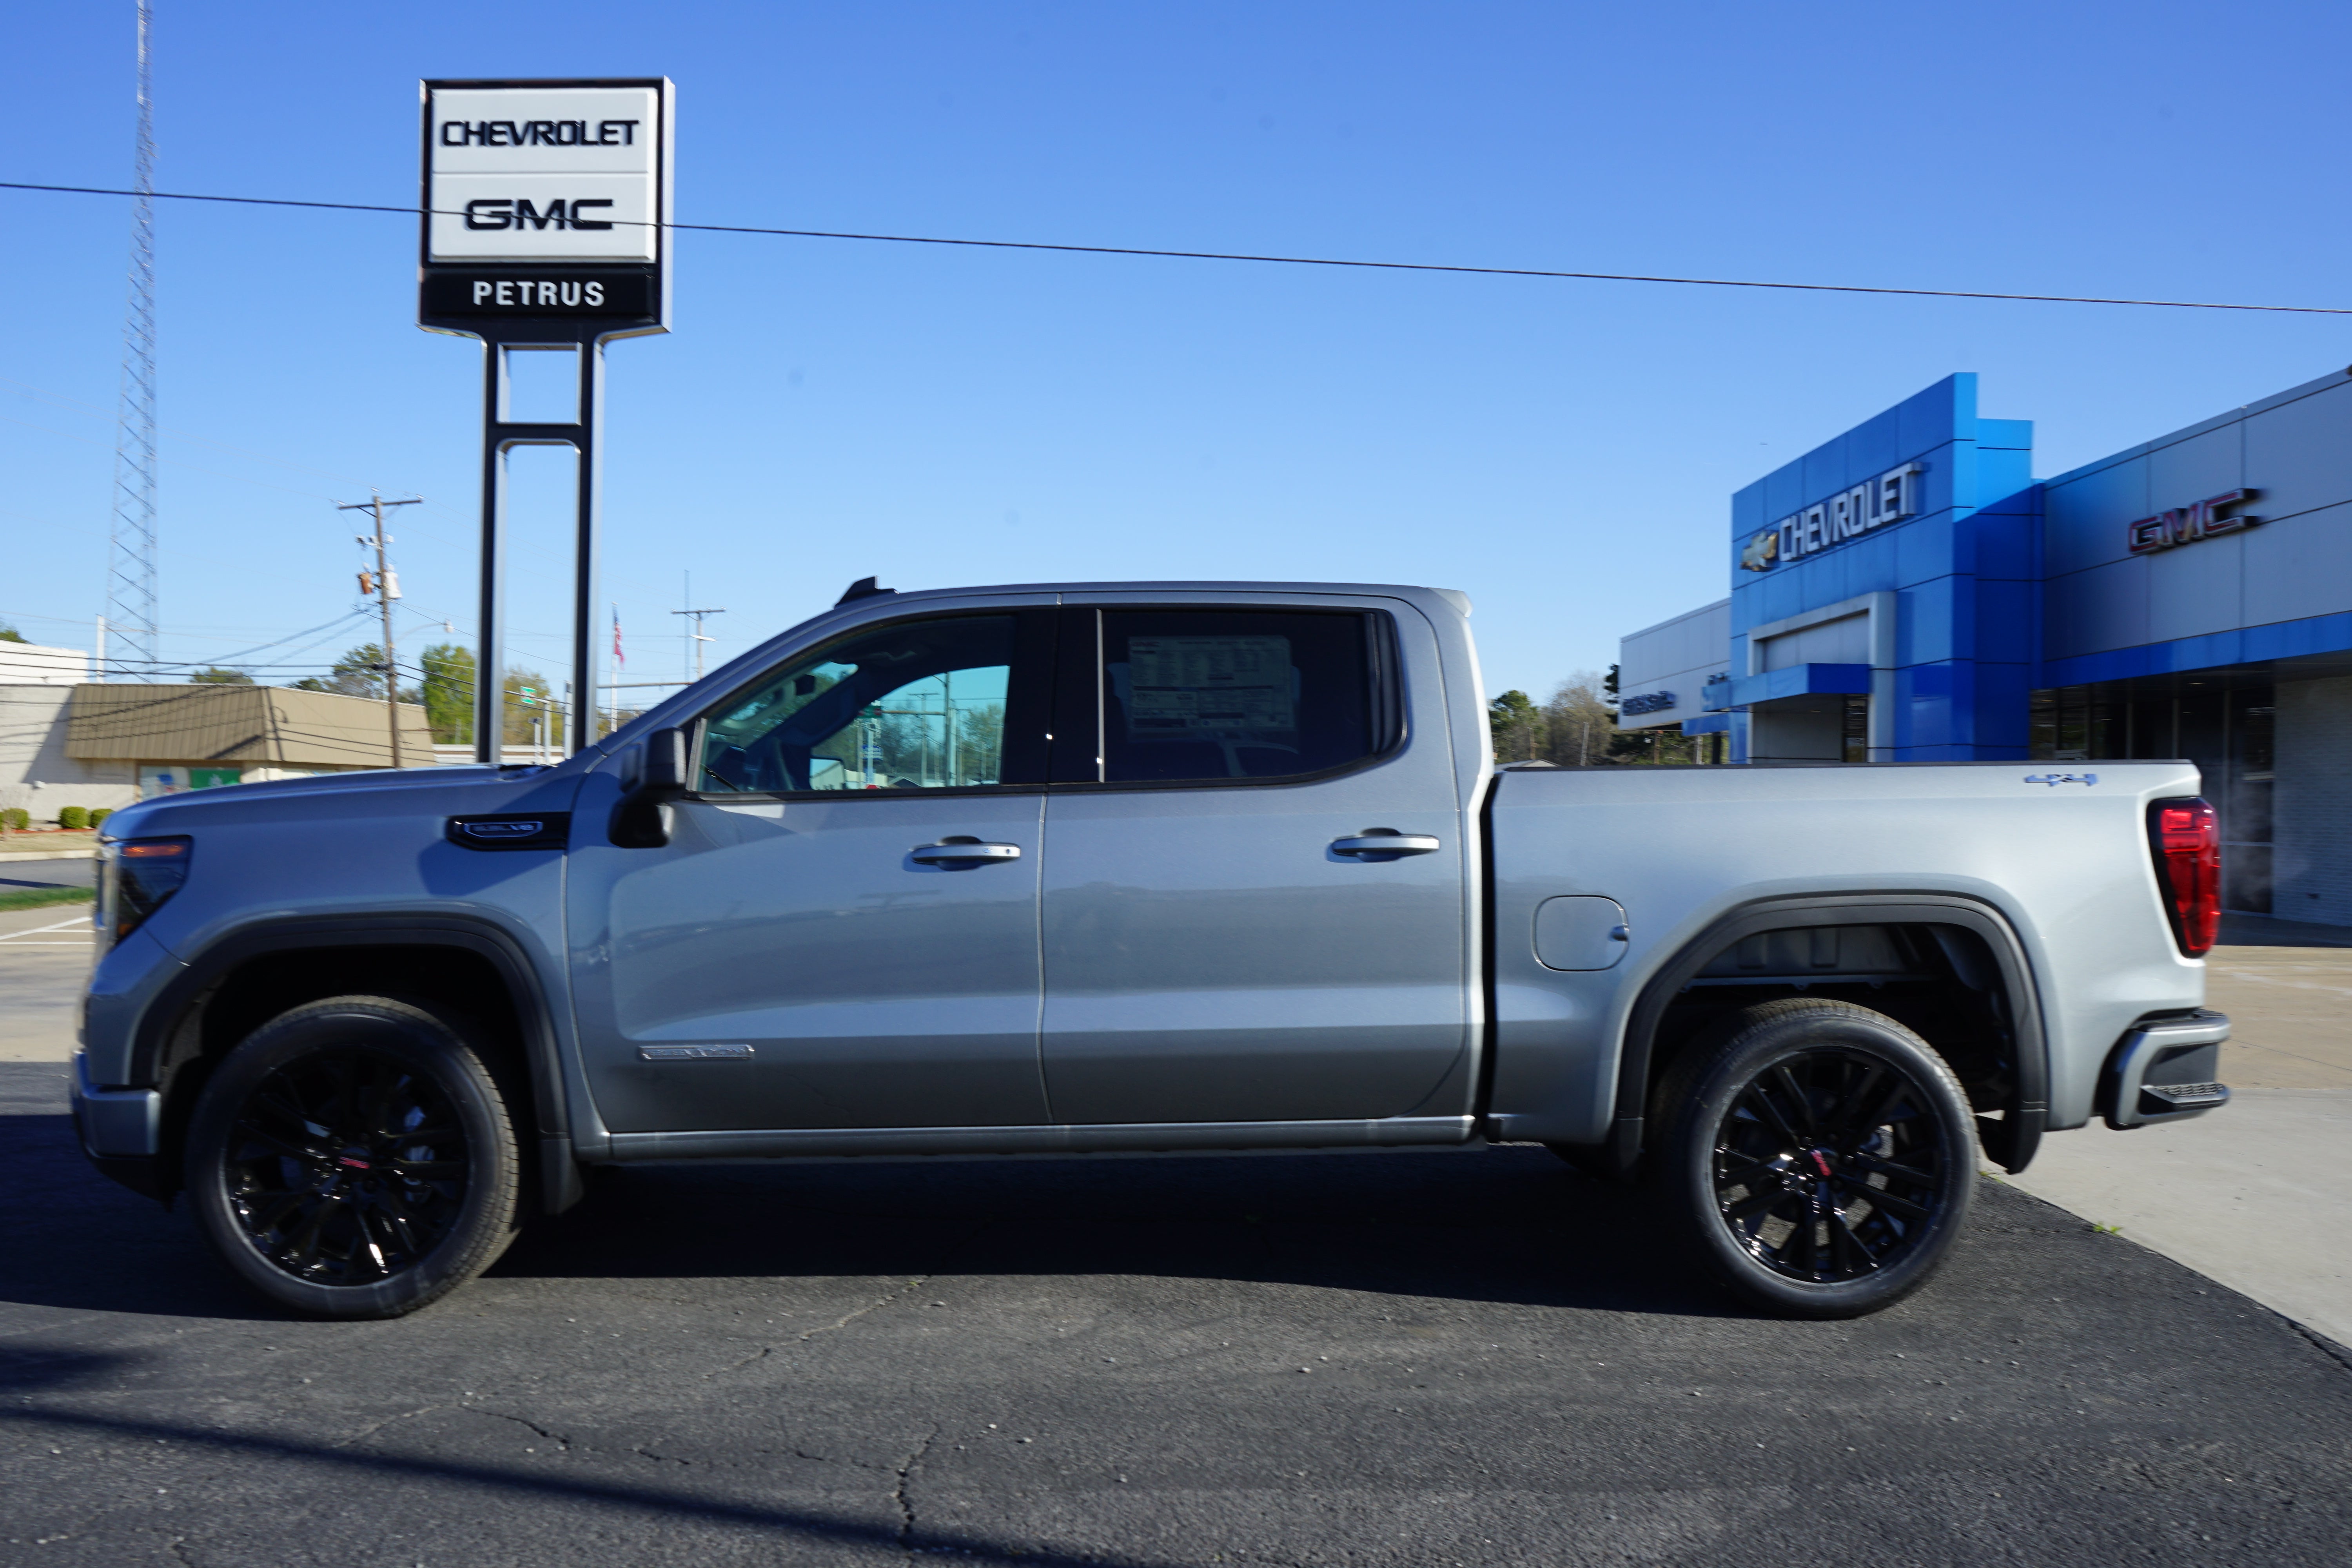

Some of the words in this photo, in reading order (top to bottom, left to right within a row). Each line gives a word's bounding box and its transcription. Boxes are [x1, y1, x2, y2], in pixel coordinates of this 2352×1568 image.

[441, 119, 640, 146] CHEVROLET
[465, 198, 615, 230] GMC
[473, 281, 605, 306] PETRUS
[1779, 461, 1923, 562] CHEVROLET
[2129, 487, 2261, 554] GMC
